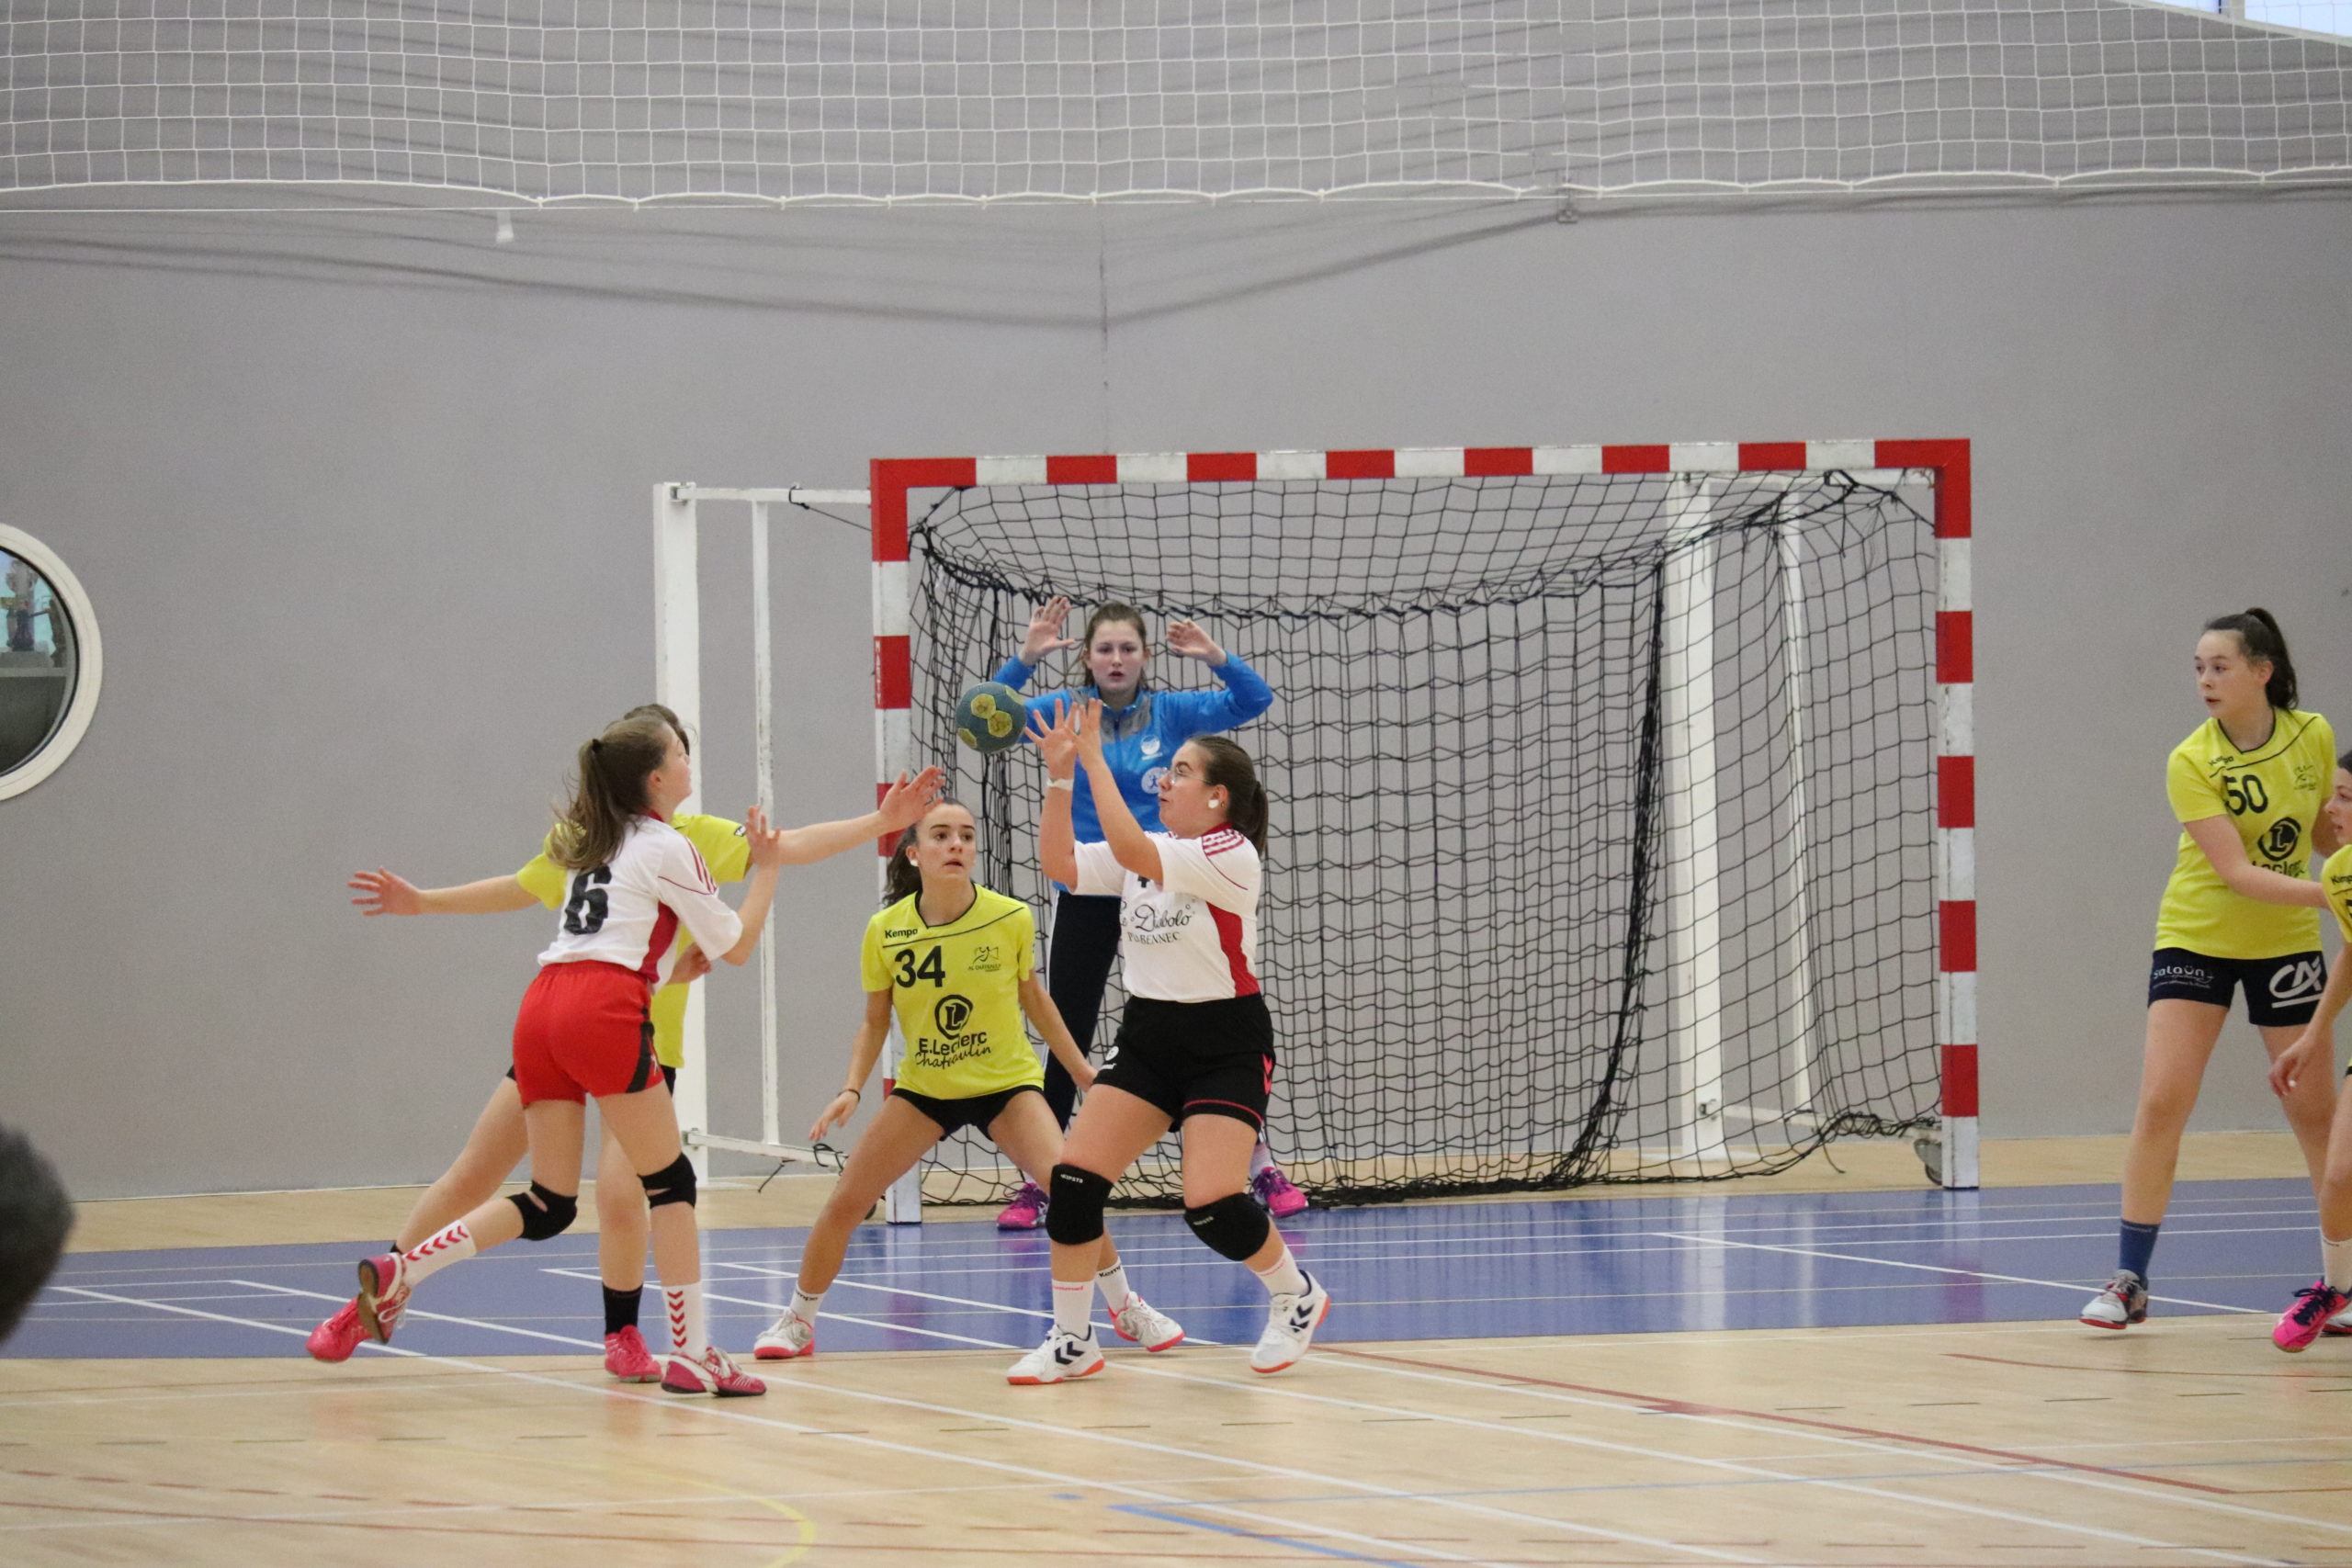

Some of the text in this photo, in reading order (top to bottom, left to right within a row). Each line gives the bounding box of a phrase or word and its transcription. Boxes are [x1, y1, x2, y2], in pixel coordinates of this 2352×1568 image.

[2222, 774, 2268, 816] 50
[564, 864, 613, 936] 6
[885, 928, 919, 939] Kempa
[895, 944, 945, 988] 34
[919, 1032, 988, 1055] E.Leclerc
